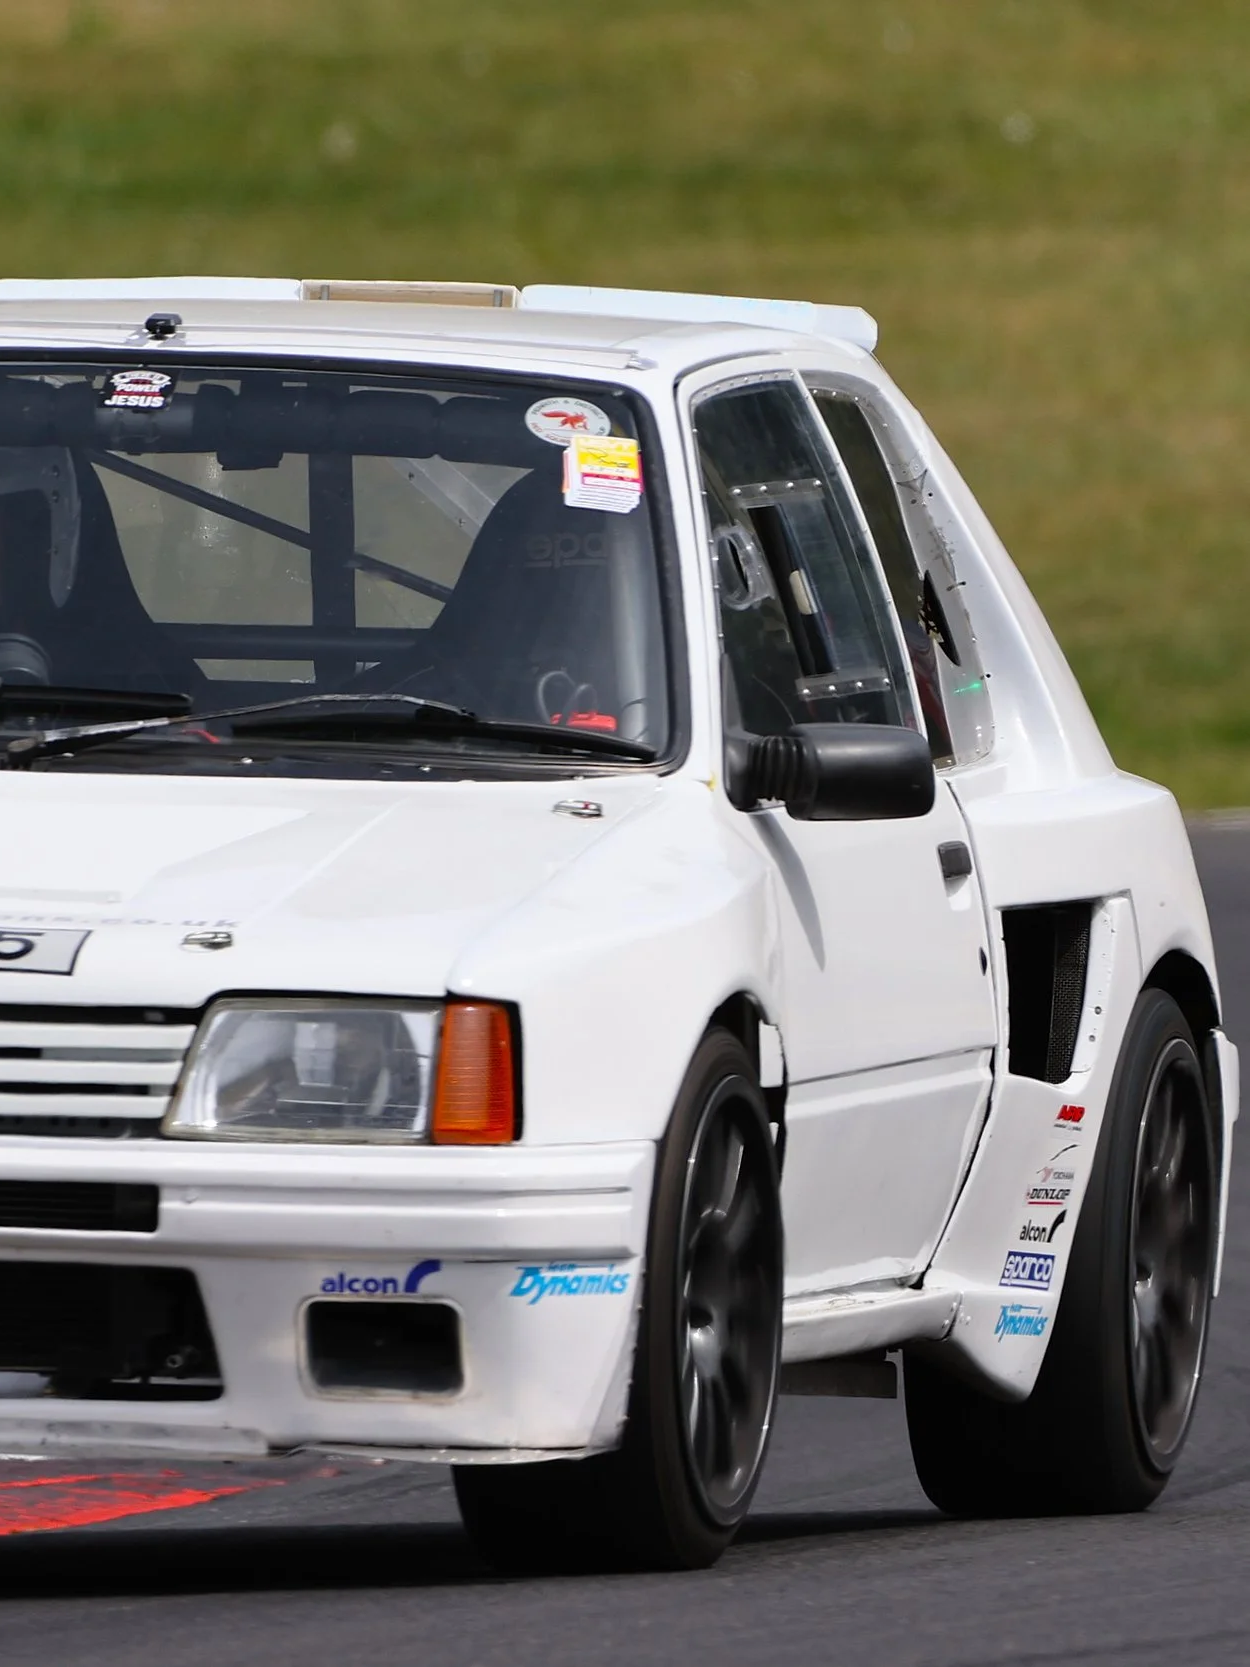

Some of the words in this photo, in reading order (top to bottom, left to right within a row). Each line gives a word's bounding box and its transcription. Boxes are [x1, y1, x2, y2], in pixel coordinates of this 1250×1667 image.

[116, 384, 161, 392] POWER
[104, 395, 165, 408] JESUS
[1028, 1188, 1071, 1200] DUNLOP
[1019, 1219, 1048, 1243] alcon
[1004, 1252, 1054, 1284] sparco
[320, 1272, 399, 1294] alcon
[508, 1265, 631, 1305] Dynamics
[994, 1304, 1049, 1343] Dynamics
